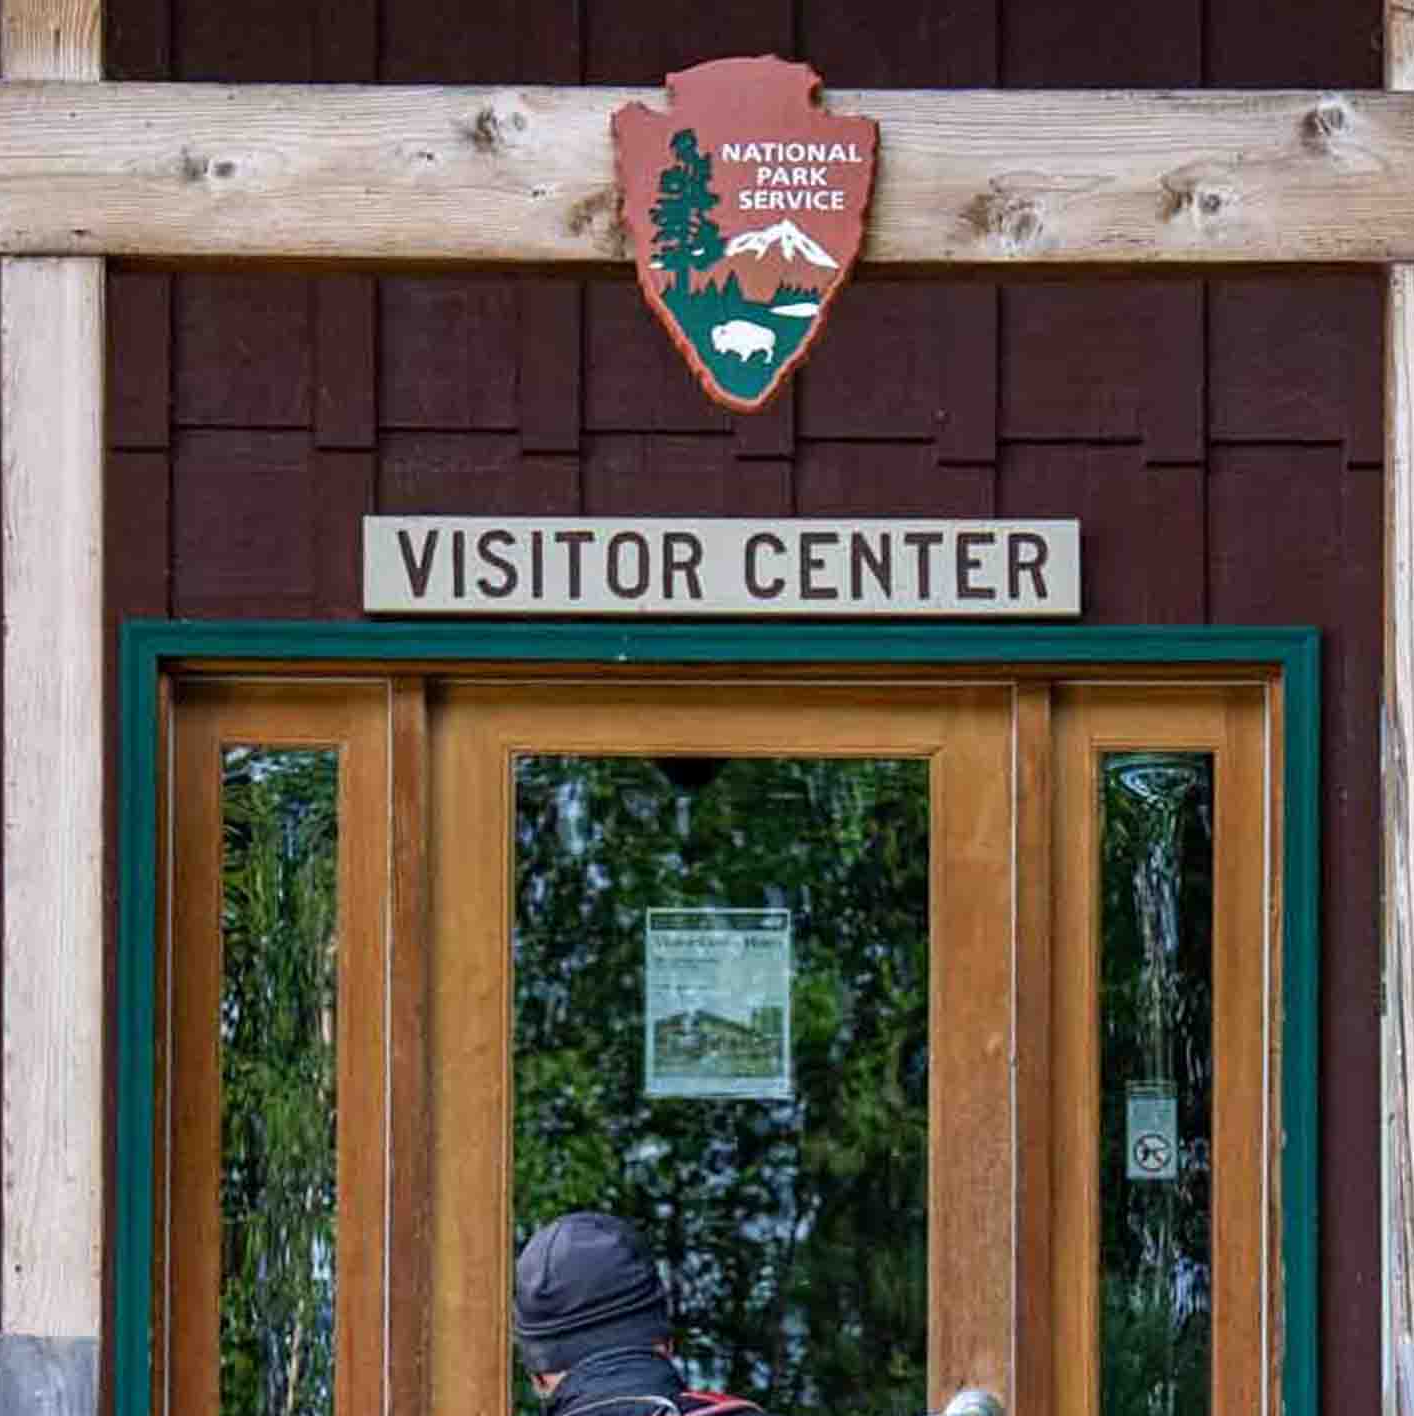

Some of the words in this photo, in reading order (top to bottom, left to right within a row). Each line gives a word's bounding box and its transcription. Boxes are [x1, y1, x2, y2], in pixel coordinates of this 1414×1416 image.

[722, 143, 863, 162] NATIONAL
[756, 167, 828, 186] PARK
[738, 191, 844, 210] SERVICE
[397, 529, 704, 599] VISITOR
[744, 531, 1048, 600] CENTER
